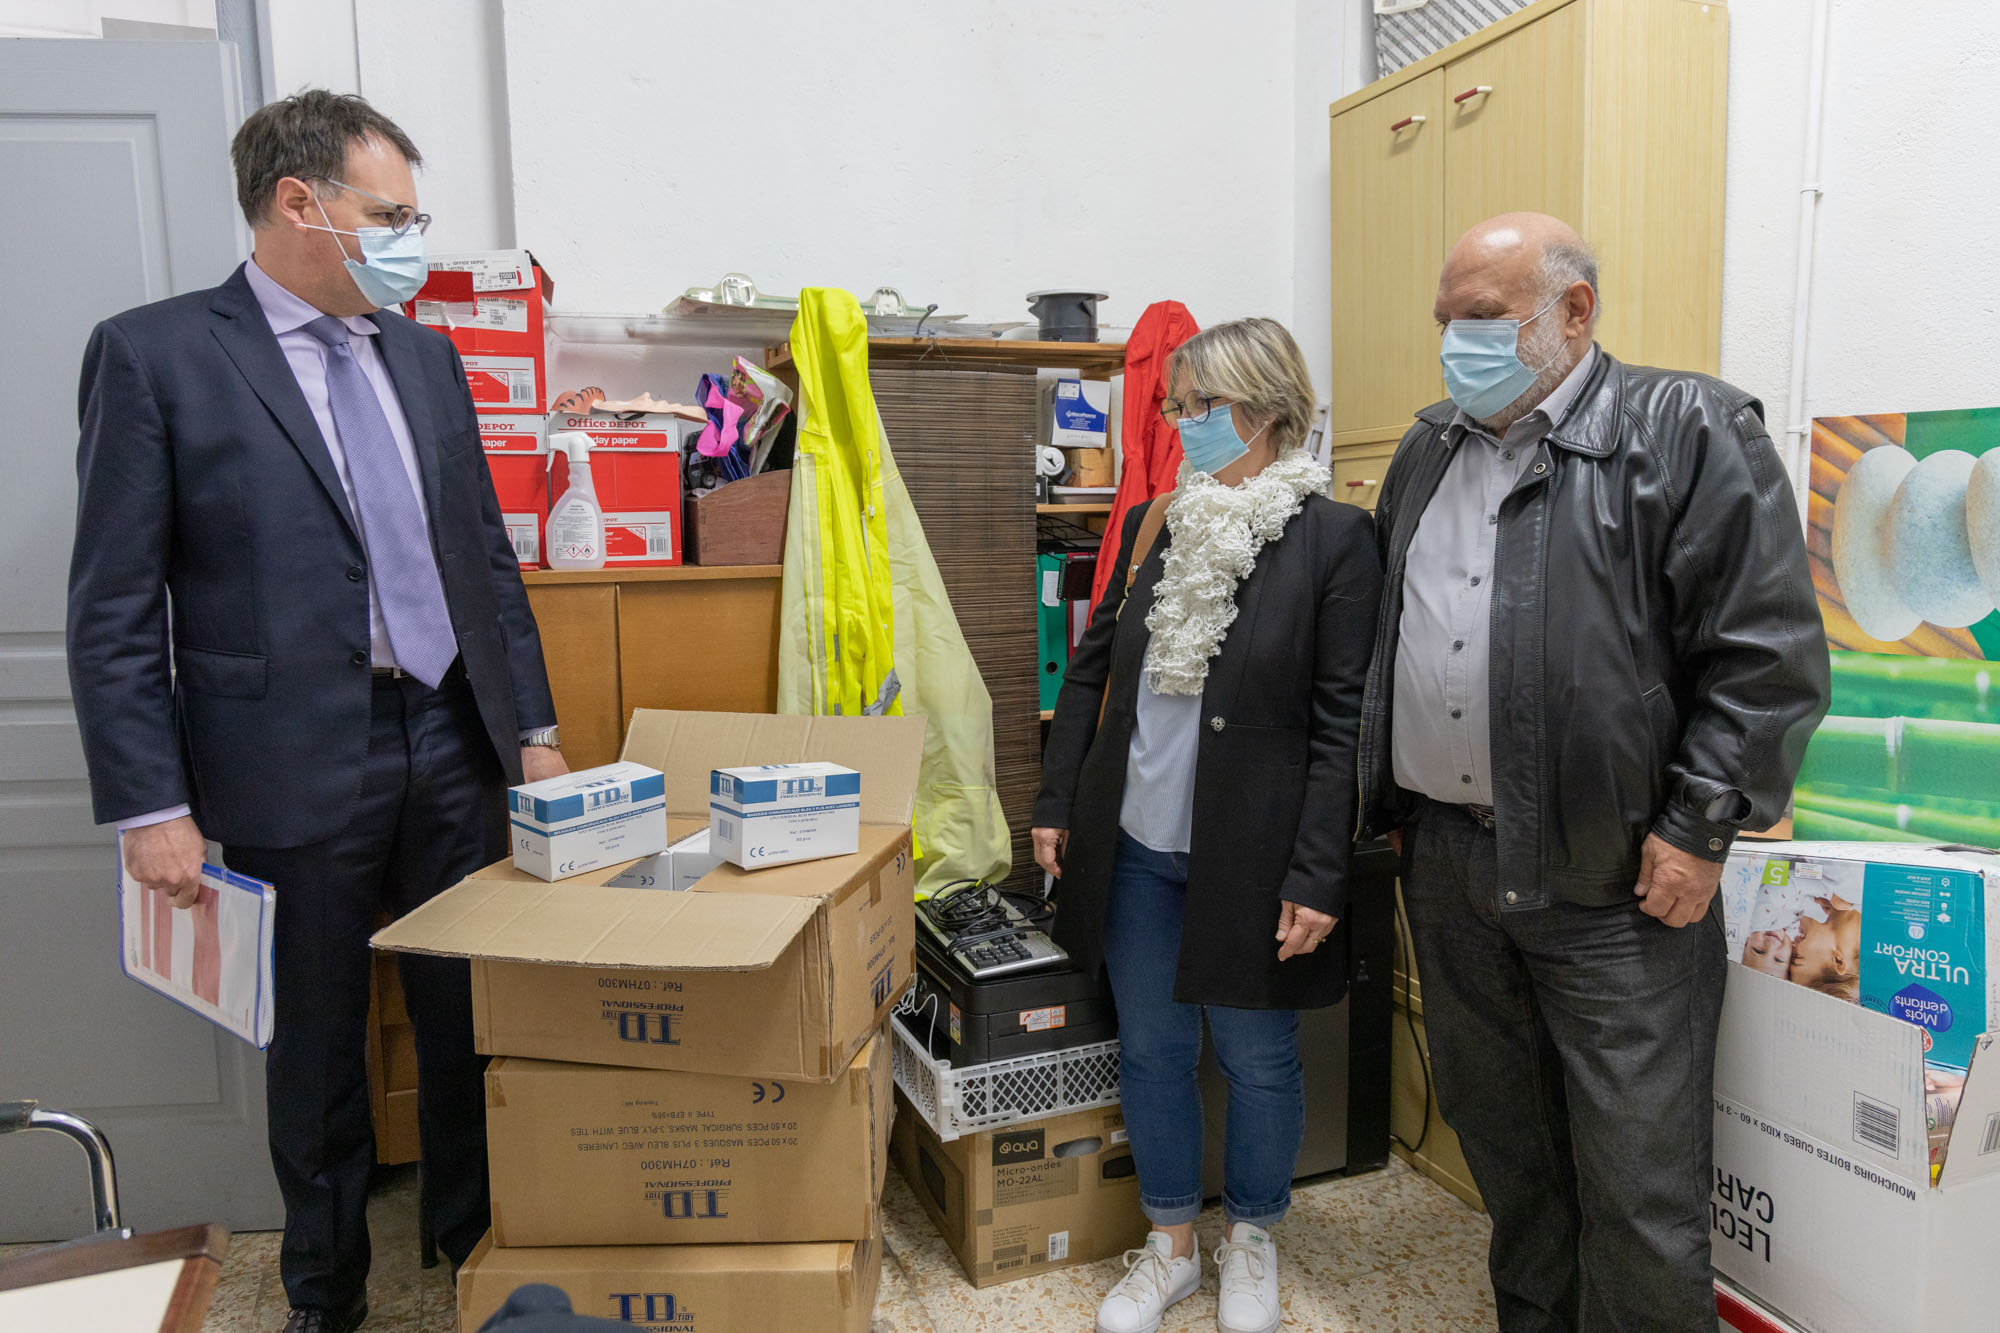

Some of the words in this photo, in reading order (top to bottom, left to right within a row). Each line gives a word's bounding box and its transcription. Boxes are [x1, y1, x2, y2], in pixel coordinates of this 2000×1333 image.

[567, 418, 607, 428] Office
[594, 435, 610, 446] day
[612, 436, 639, 445] paper
[782, 776, 815, 794] TD
[588, 786, 621, 808] TD
[750, 846, 765, 858] CE
[560, 861, 574, 873] CE
[1770, 866, 1784, 884] 5
[1874, 942, 1950, 964] CONFORT
[1894, 957, 1969, 985] ULTRA
[598, 978, 650, 990] 07HM300
[600, 1000, 684, 1012] PROFESSIONAL
[1895, 996, 1948, 1014] d'enfants
[600, 1011, 616, 1019] TIDY
[1905, 1008, 1938, 1026] Mots
[618, 1012, 680, 1046] TD
[752, 1082, 785, 1104] CE
[1713, 1101, 1724, 1112] PL
[1726, 1107, 1732, 1116] 3
[1740, 1113, 1751, 1123] 60
[1753, 1118, 1759, 1126] x
[592, 1127, 614, 1135] WITH
[617, 1126, 639, 1134] BLUE
[701, 1124, 743, 1132] SURGICAL
[747, 1123, 769, 1132] PCES
[770, 1122, 780, 1131] 50
[787, 1122, 797, 1130] 20
[1761, 1122, 1781, 1138] KIDS
[570, 1128, 589, 1136] TIES
[578, 1142, 618, 1151] LANIERES
[623, 1141, 644, 1150] AVEC
[648, 1141, 669, 1149] BLEU
[672, 1140, 691, 1149] PLIS
[703, 1139, 743, 1148] MASQUES
[748, 1138, 770, 1147] PCES
[771, 1138, 781, 1146] 50
[788, 1138, 798, 1146] 20
[1784, 1132, 1814, 1153] CUBES
[640, 1160, 696, 1170] 07HM300
[1816, 1148, 1850, 1171] BOITES
[997, 1160, 1062, 1176] Micro-ondes
[641, 1179, 732, 1188] PROFESSIONAL
[997, 1174, 1044, 1188] MO-22AL
[1854, 1164, 1916, 1200] MOUCHOIRS
[644, 1191, 661, 1200] TIDY
[1712, 1165, 1774, 1224] CAR
[662, 1190, 728, 1219] TD
[608, 1293, 677, 1323] TD
[677, 1313, 696, 1321] TIDY
